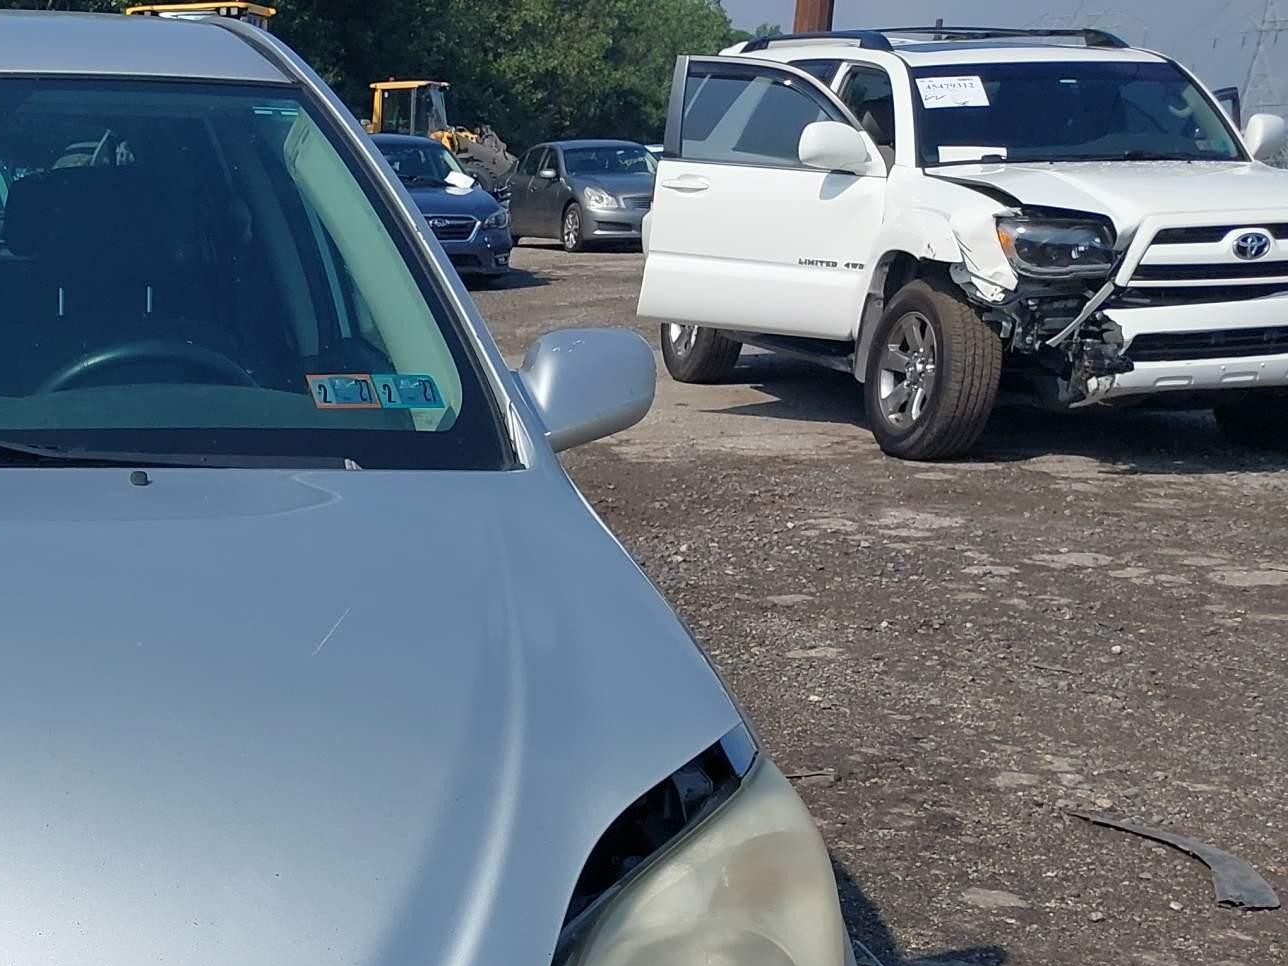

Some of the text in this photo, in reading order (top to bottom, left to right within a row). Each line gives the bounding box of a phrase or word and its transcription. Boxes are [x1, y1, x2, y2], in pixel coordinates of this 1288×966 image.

[798, 258, 864, 270] LIMITED 4WD
[317, 384, 332, 403] 2
[382, 384, 397, 403] 2
